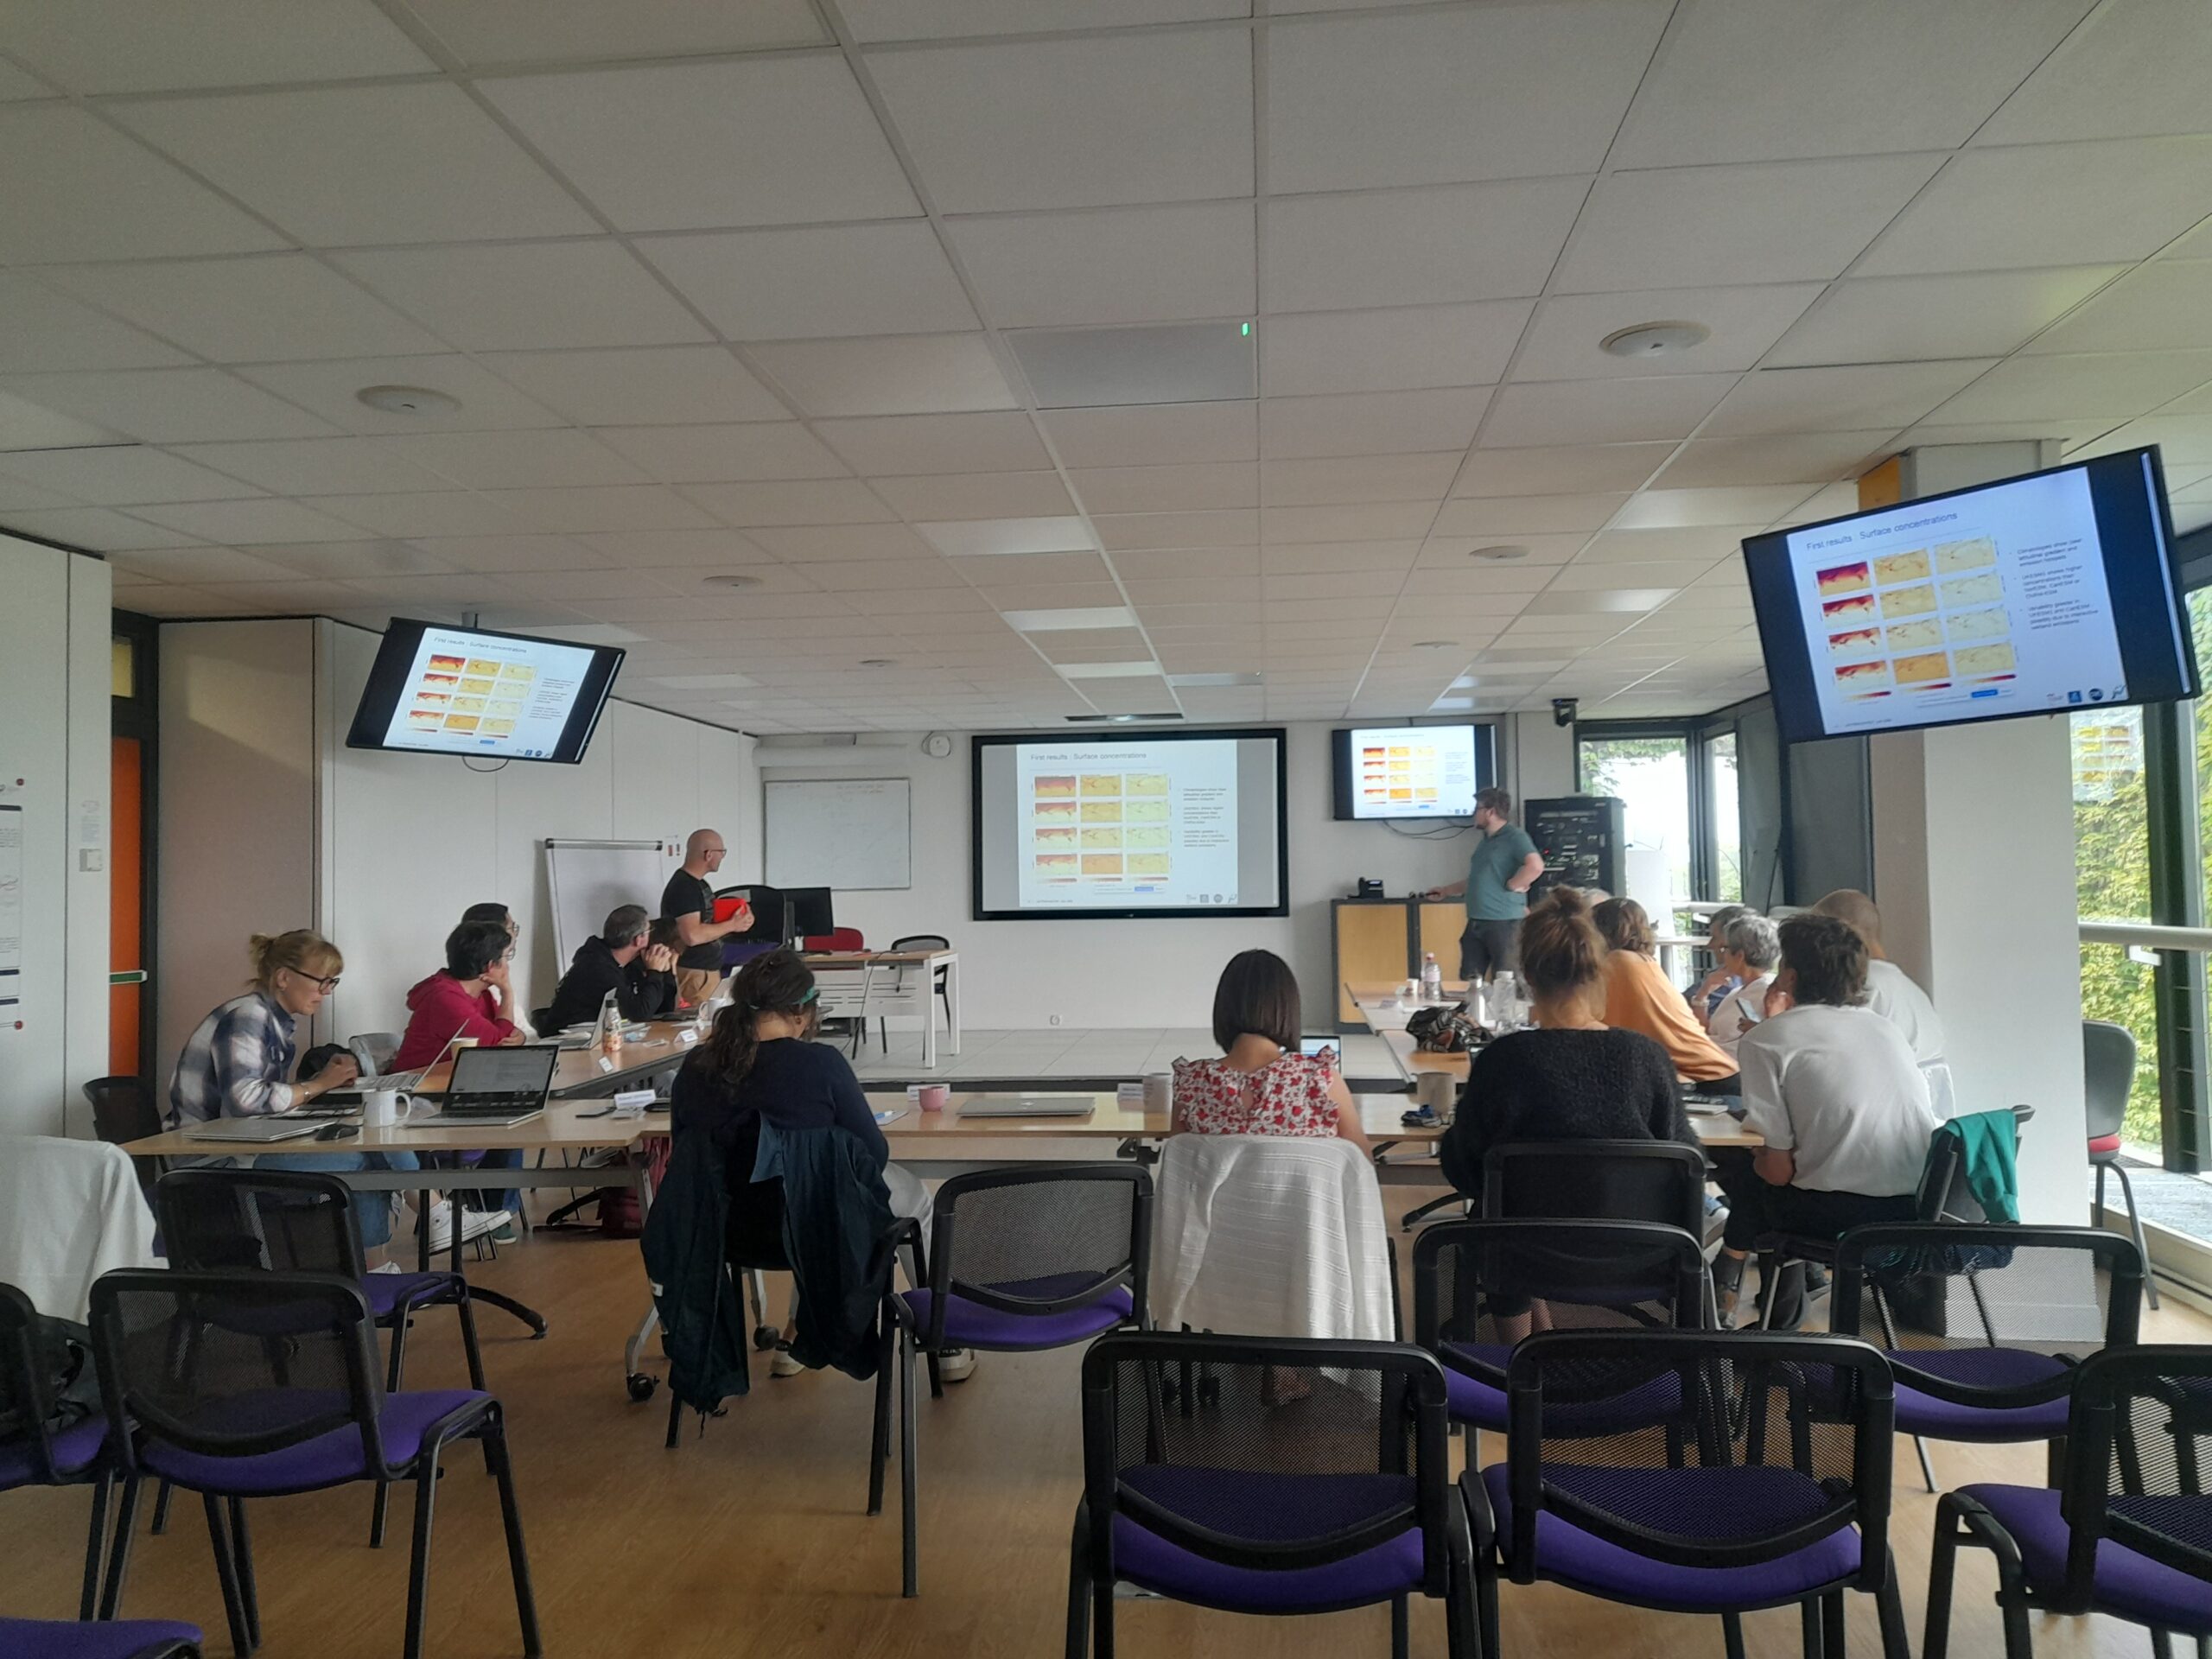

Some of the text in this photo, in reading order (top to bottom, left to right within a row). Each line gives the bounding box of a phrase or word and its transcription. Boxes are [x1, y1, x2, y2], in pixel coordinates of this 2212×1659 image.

[1806, 512, 1958, 550] First results Surface concentrations
